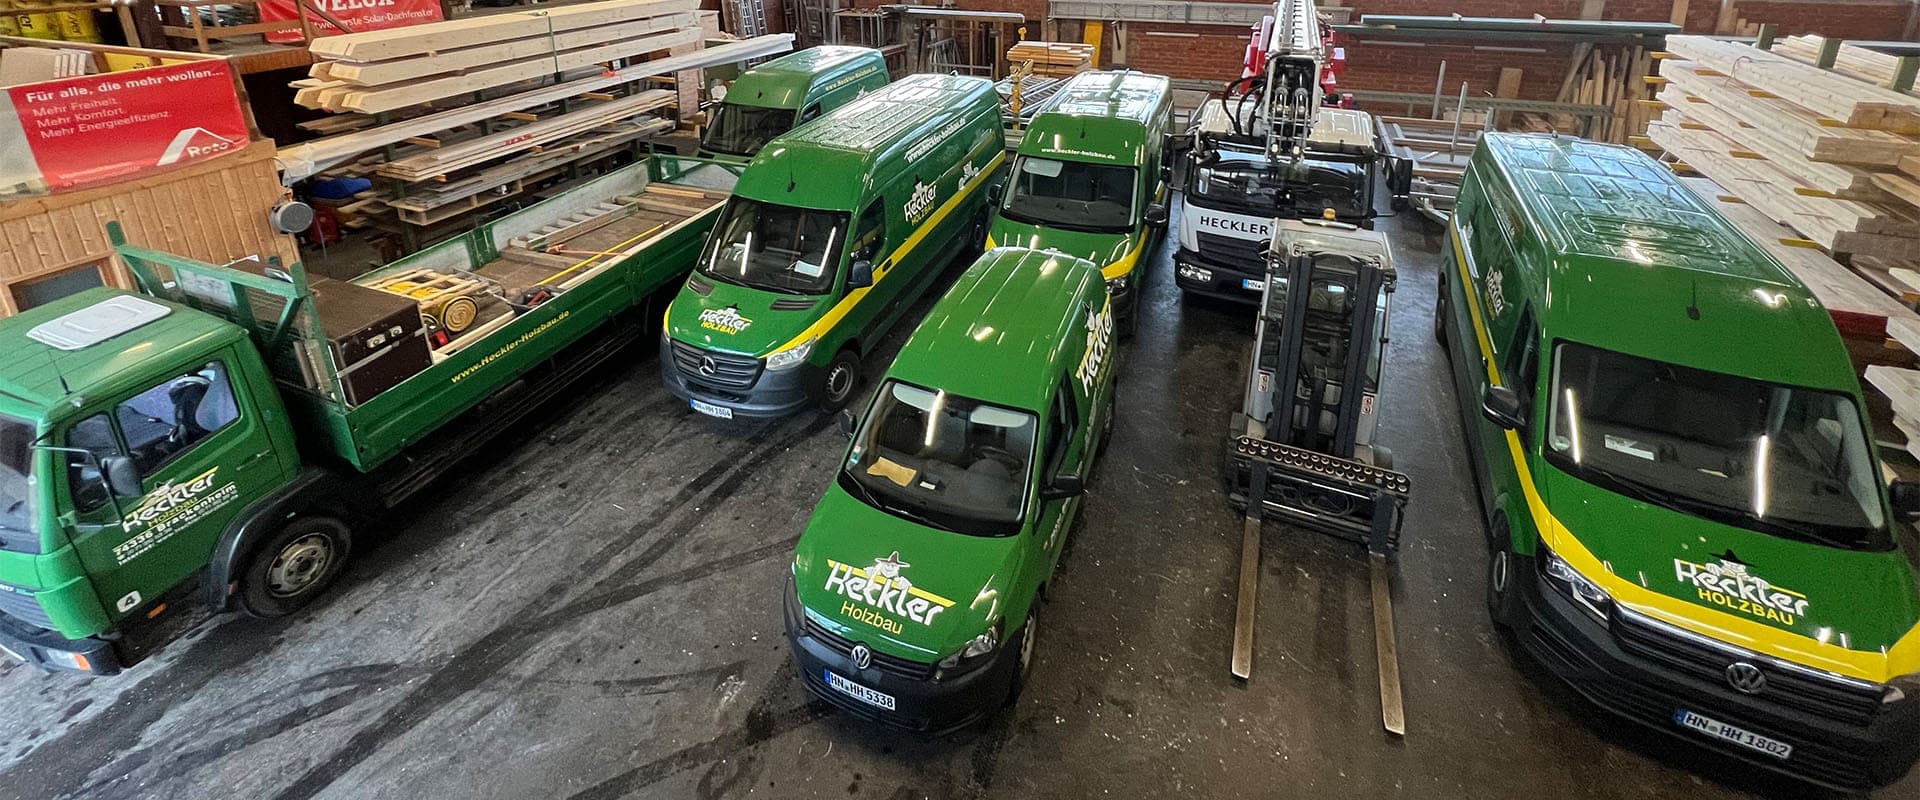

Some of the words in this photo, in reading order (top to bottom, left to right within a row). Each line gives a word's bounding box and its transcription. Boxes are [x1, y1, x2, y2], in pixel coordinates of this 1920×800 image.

[363, 9, 433, 24] Solar-Dachfenster
[26, 90, 54, 103] Für
[60, 86, 94, 99] alle,
[97, 81, 122, 93] die
[126, 75, 163, 89] mehr
[166, 69, 224, 82] wollen...
[32, 103, 67, 117] Mehr
[70, 97, 120, 111] Freiheit.
[37, 115, 71, 129] Mehr
[75, 108, 126, 122] Komfort.
[40, 125, 75, 139] Mehr
[187, 141, 229, 158] Roto
[903, 185, 937, 221] Heckler
[1200, 216, 1268, 235] HECKLER
[698, 309, 751, 331] Heckler
[451, 310, 569, 383] www.Heckler-Holzbau.de
[116, 531, 153, 555] 74336
[157, 484, 236, 531] Brackenheim
[122, 473, 215, 533] Heckler
[124, 596, 136, 607] 4
[824, 561, 944, 626] Heckler
[1674, 558, 1809, 616] Heckler
[840, 600, 903, 635] Holzbau
[1697, 588, 1793, 626] HOLZBAU
[831, 674, 844, 688] HN
[850, 683, 864, 697] HH
[866, 690, 893, 708] 5338
[1685, 714, 1708, 729] HN
[1720, 726, 1742, 740] HH
